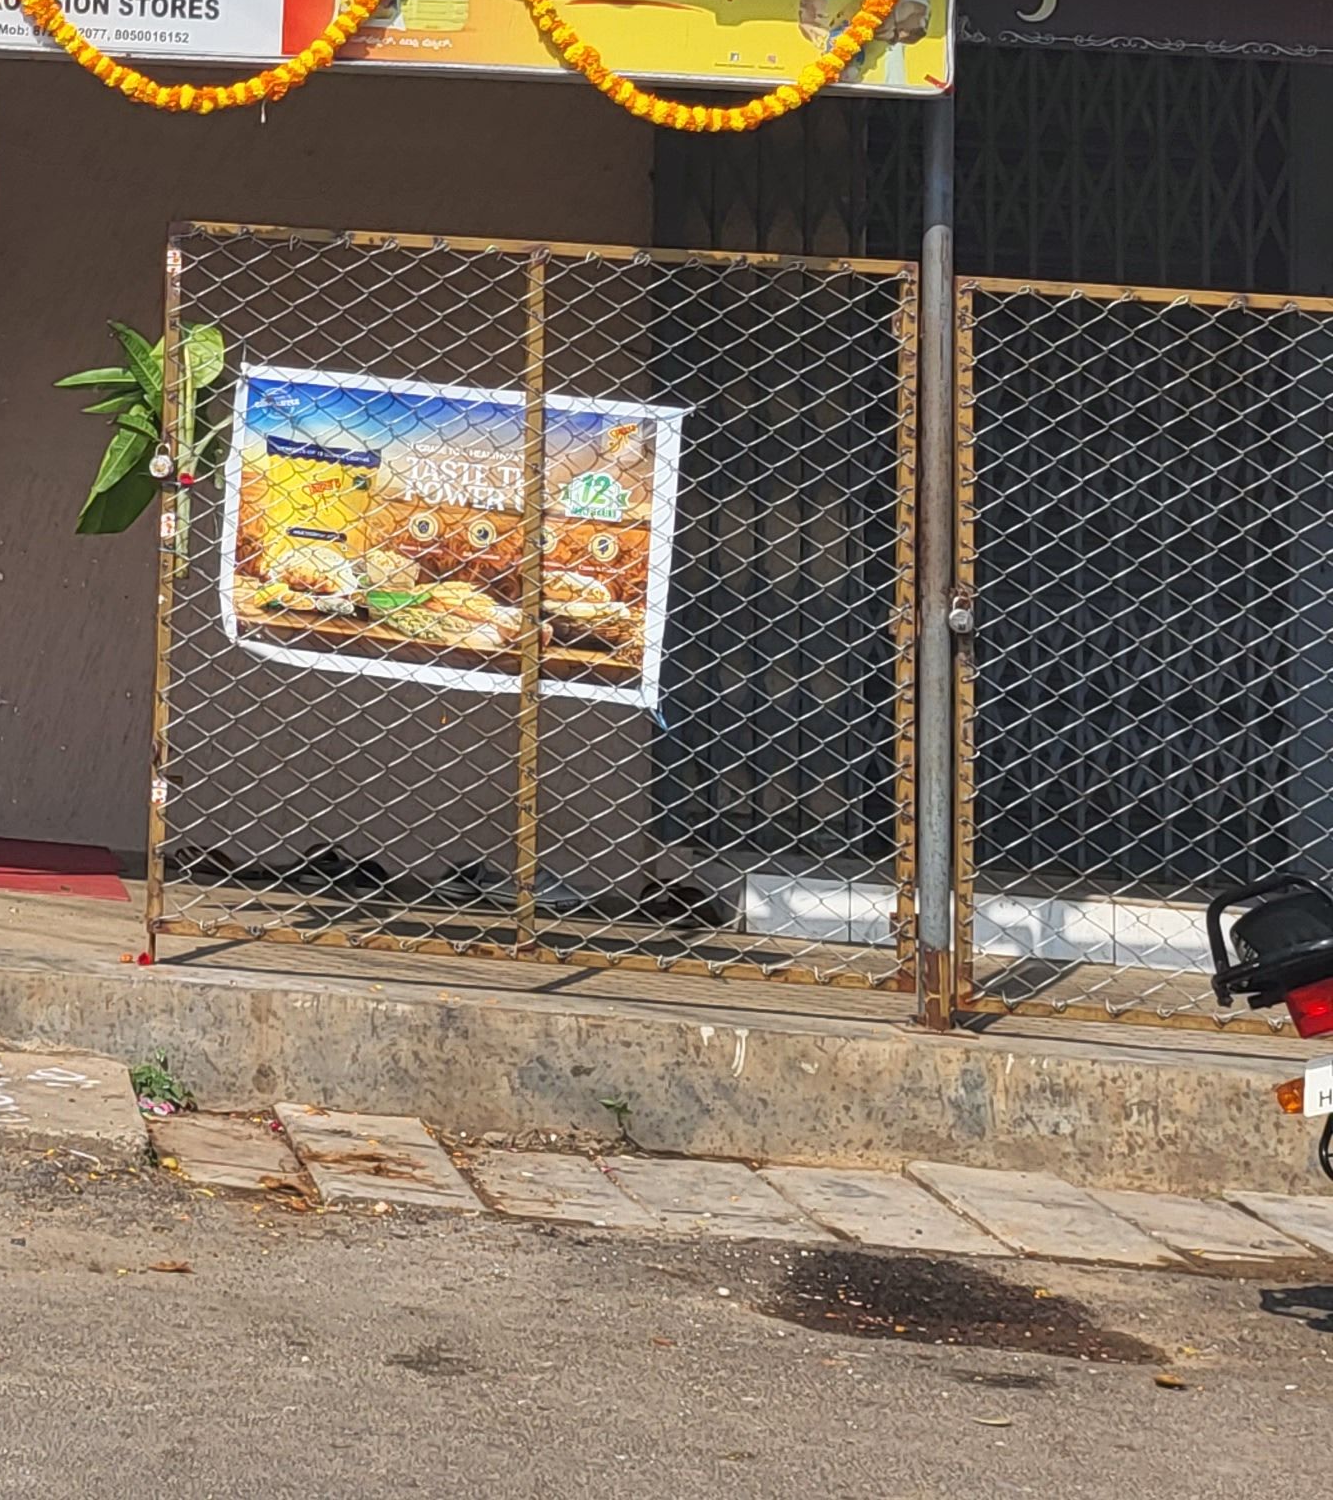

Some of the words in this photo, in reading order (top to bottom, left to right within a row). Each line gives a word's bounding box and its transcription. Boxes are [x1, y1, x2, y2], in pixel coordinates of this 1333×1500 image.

[114, 29, 190, 44] 8050016152
[406, 457, 489, 488] TASTE
[582, 474, 611, 504] 12
